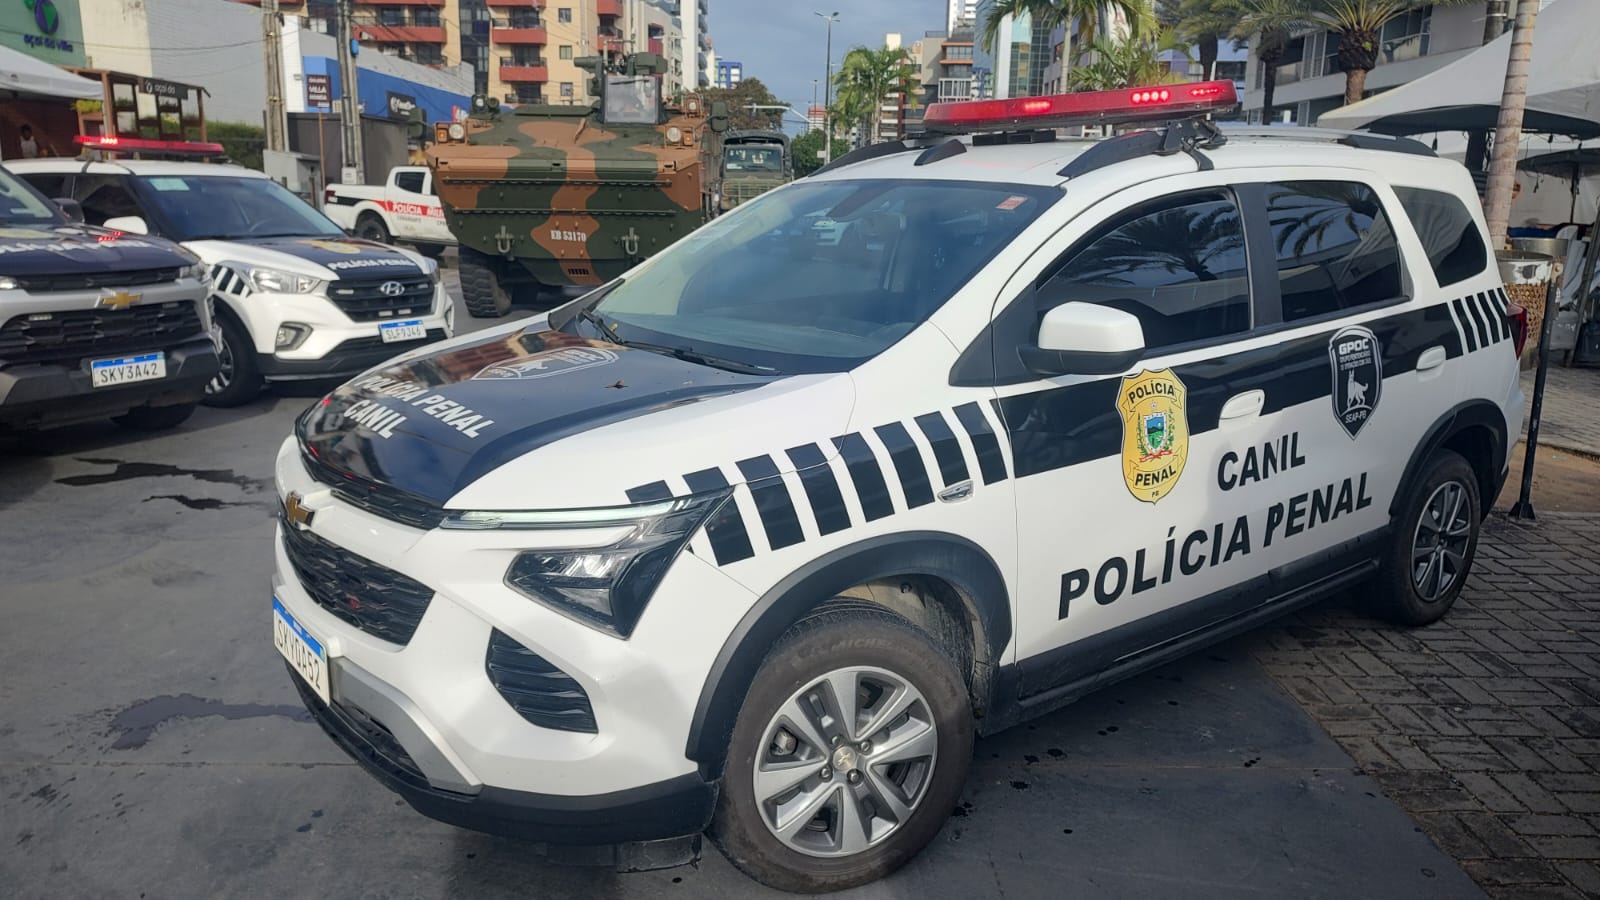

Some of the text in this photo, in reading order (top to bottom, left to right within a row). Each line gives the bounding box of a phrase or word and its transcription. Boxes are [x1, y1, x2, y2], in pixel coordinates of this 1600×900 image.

[563, 231, 587, 243] 53170
[1338, 338, 1369, 355] GPOC
[100, 362, 158, 384] SKY3A42
[1127, 379, 1176, 405] POLÍCIA
[343, 399, 408, 440] CANIL
[355, 375, 495, 440] POLÍCIA PENAL
[1217, 431, 1306, 492] CANIL
[1134, 465, 1178, 488] PENAL
[1057, 471, 1373, 621] POLÍCIA PENAL
